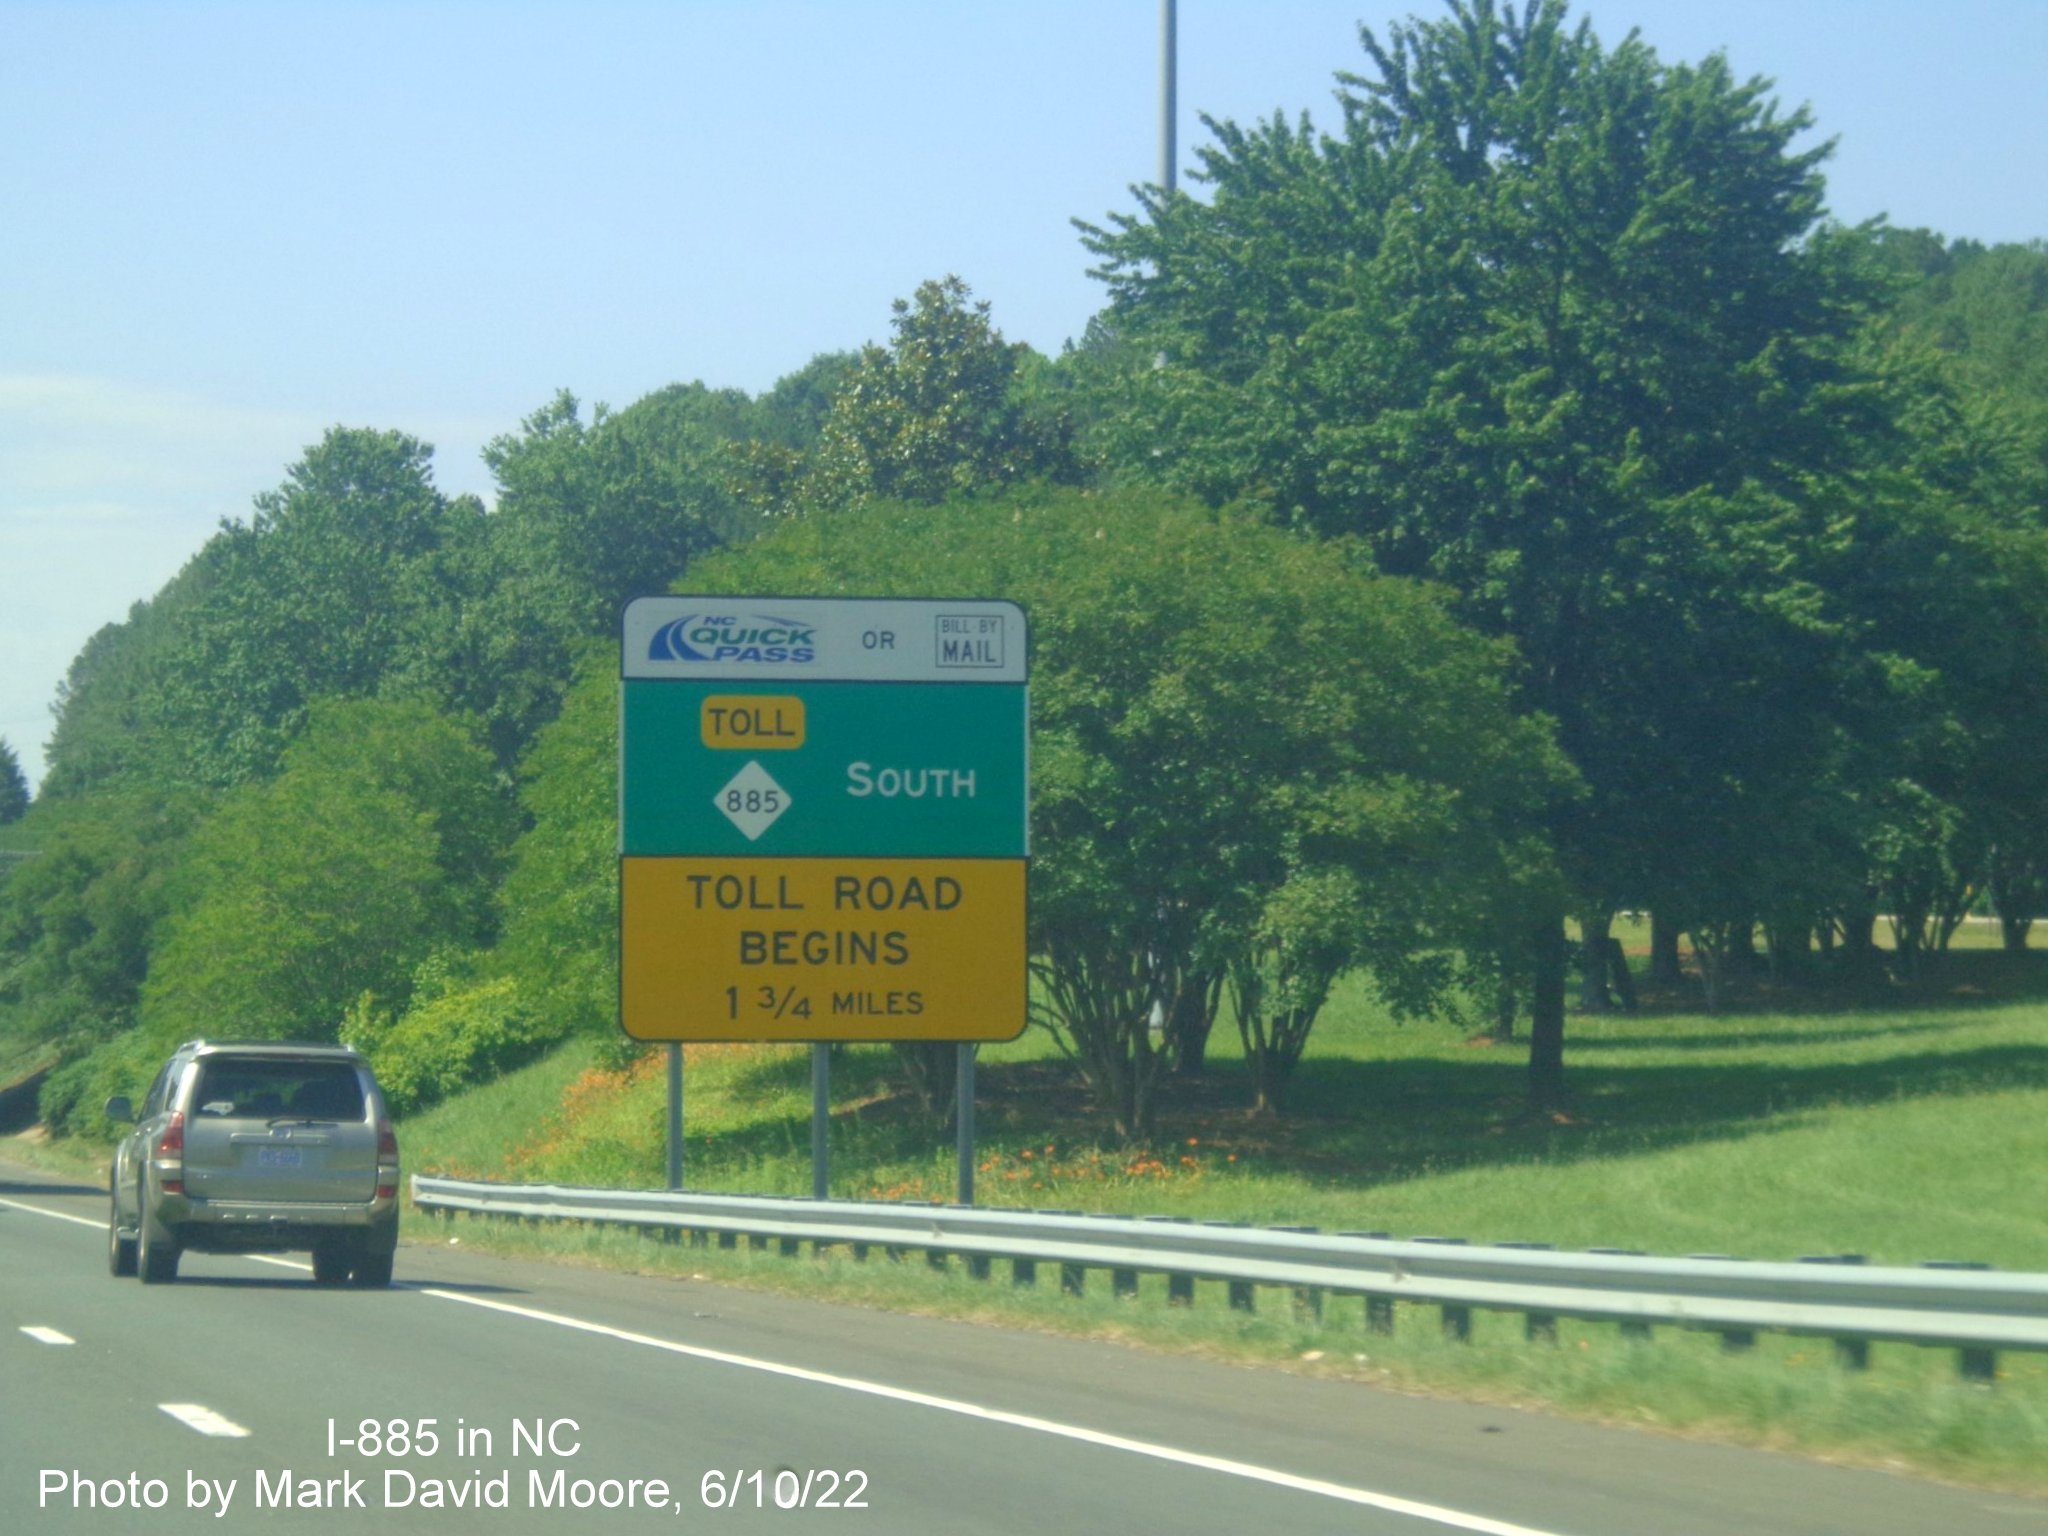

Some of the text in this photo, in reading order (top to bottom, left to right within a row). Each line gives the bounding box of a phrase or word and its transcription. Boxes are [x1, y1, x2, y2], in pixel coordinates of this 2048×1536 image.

[703, 616, 736, 626] NC
[942, 619, 997, 634] BILL BY
[689, 627, 817, 646] QUICK
[862, 631, 895, 650] OR
[714, 646, 815, 663] PASS
[942, 640, 997, 663] MAIL
[708, 708, 796, 736] TOLL
[846, 761, 976, 797] SOUTH
[725, 790, 779, 813] 885
[687, 875, 963, 911] TOLL ROAD
[740, 930, 909, 965] BEGINS
[725, 986, 738, 1019] 1
[832, 991, 924, 1016] MILES
